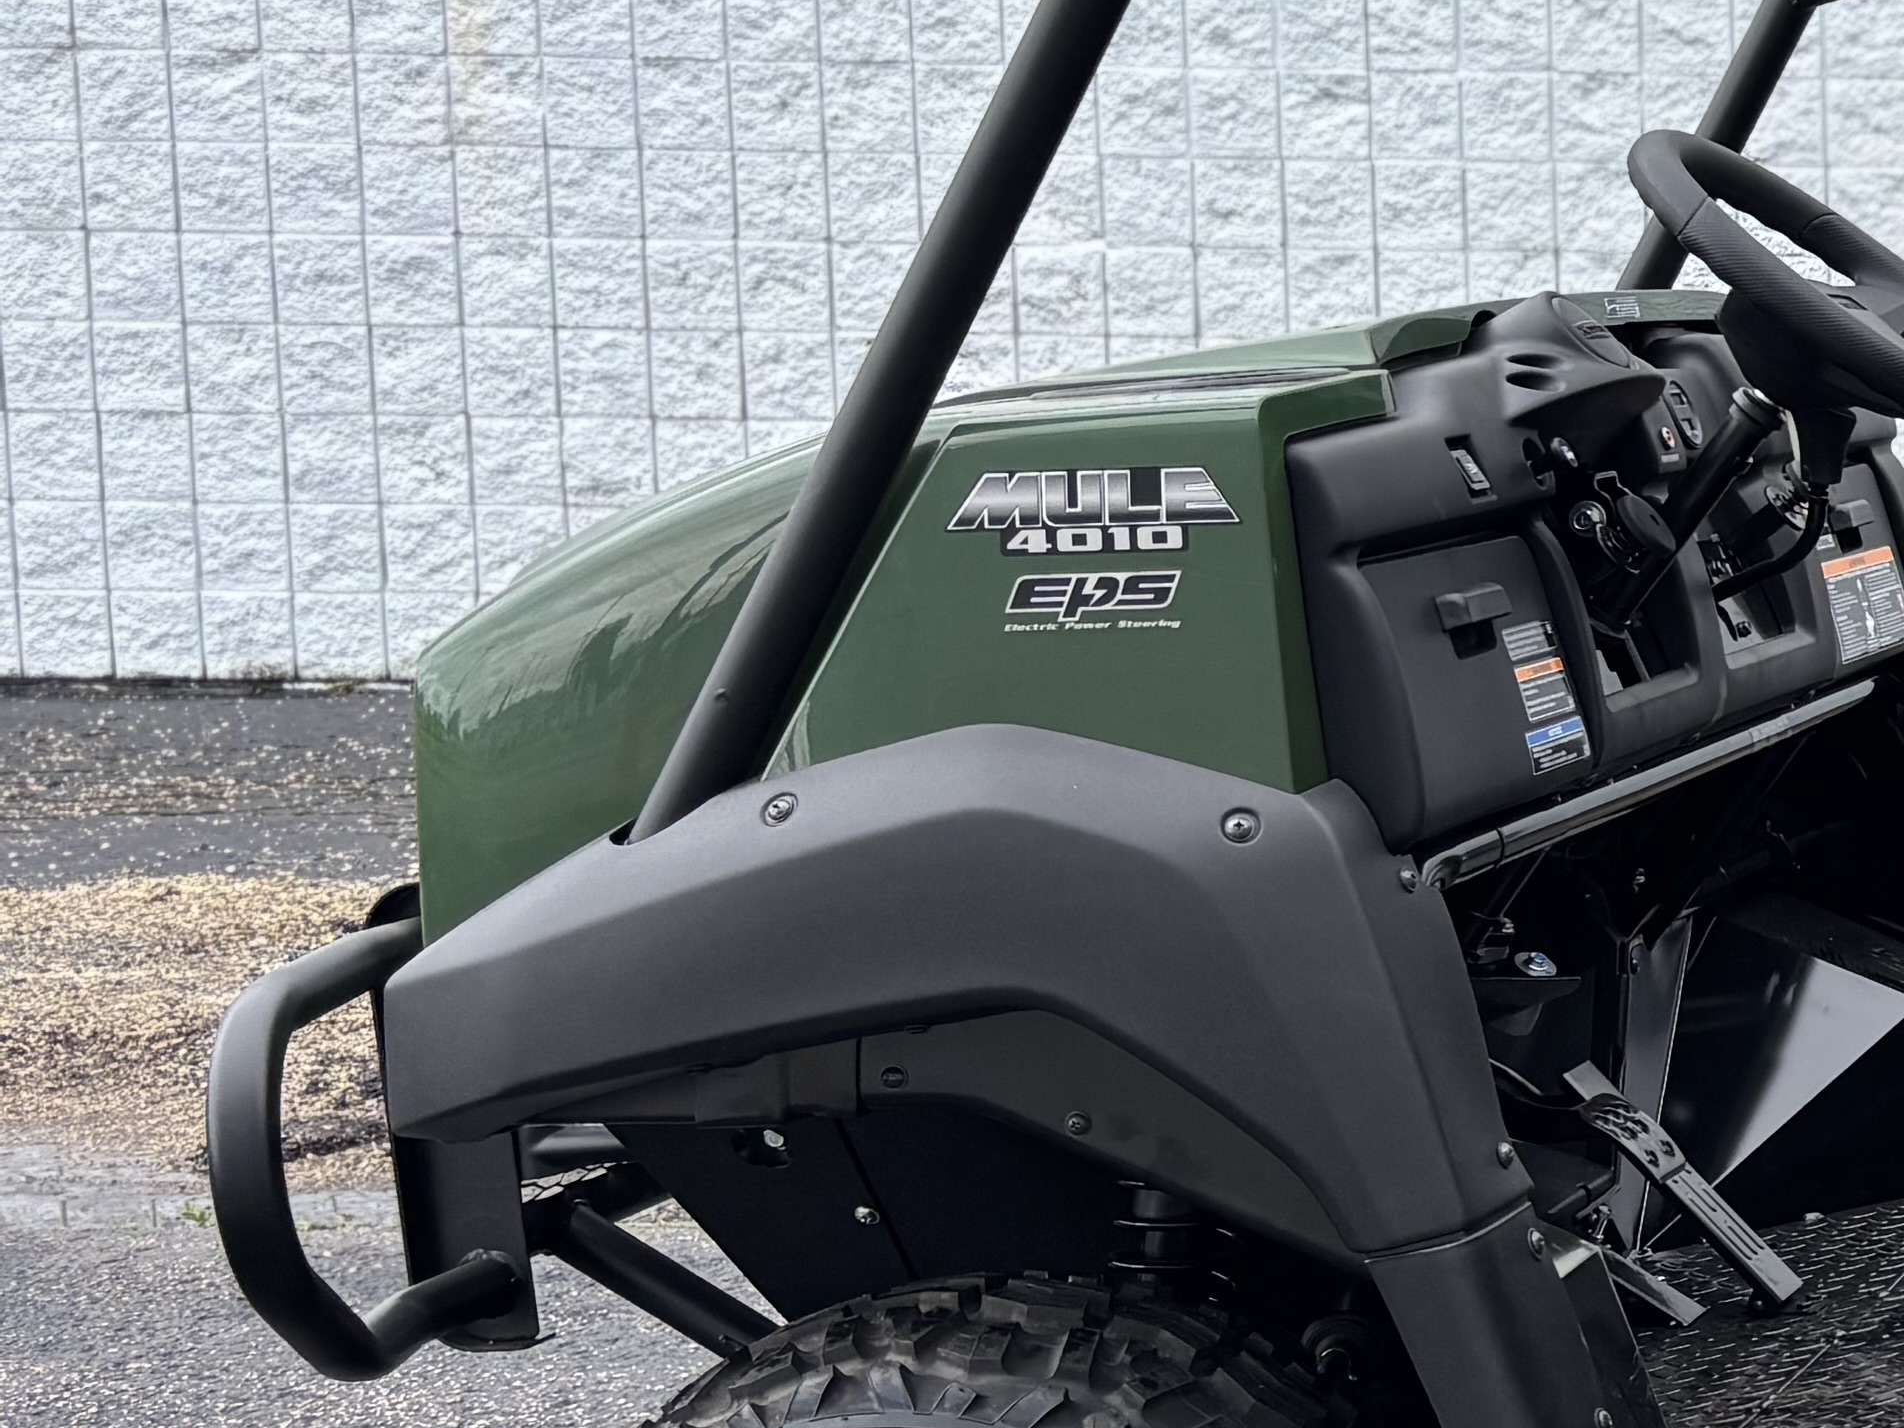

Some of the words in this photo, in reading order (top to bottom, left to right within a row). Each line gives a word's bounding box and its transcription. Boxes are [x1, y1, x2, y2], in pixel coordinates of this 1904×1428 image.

[946, 466, 1242, 531] MULE
[1006, 525, 1184, 554] 4010
[1004, 622, 1061, 632] Electric
[1064, 622, 1112, 631] Power
[1117, 619, 1182, 629] Steering
